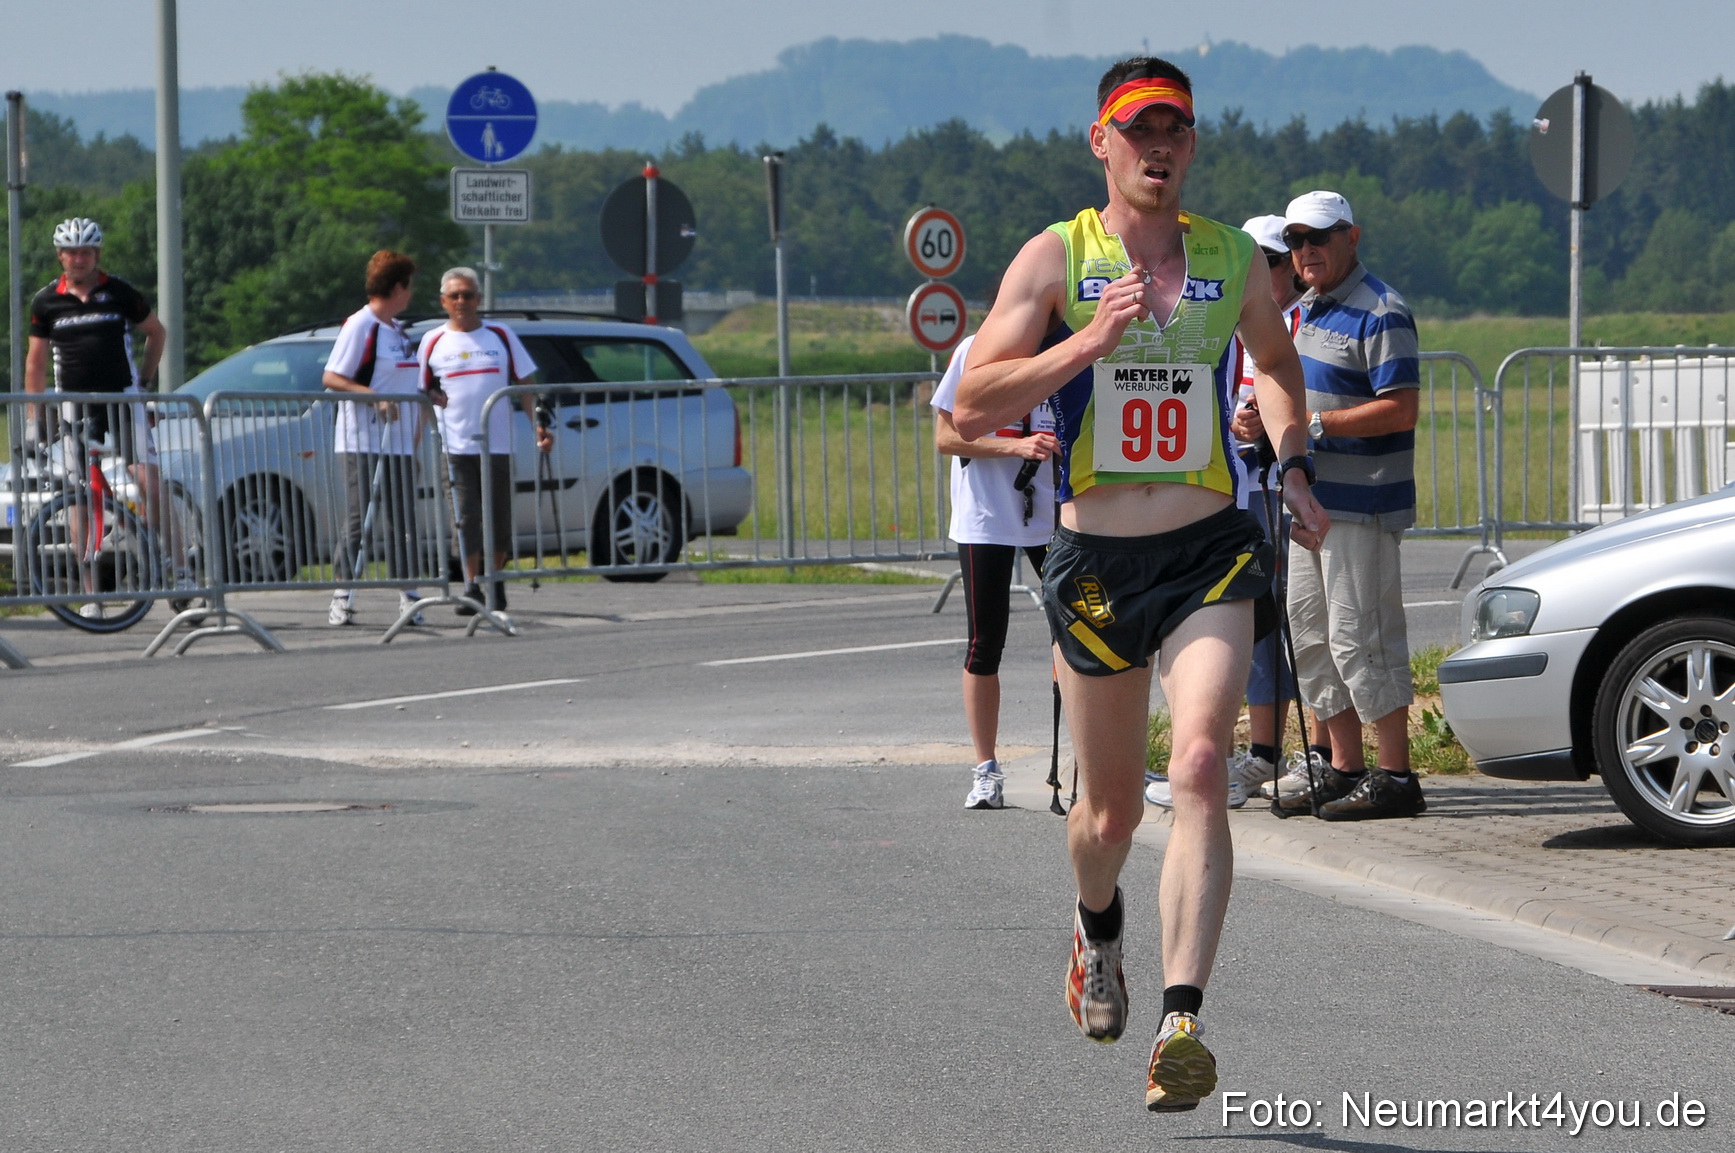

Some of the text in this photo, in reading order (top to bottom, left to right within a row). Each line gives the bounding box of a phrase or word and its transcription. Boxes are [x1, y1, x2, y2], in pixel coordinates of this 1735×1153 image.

[466, 175, 517, 188] Landwirt-
[460, 190, 522, 202] schaftlicher
[460, 203, 523, 216] Verkehr frei
[921, 228, 952, 259] 60
[1114, 369, 1169, 381] MEYER
[1114, 382, 1169, 391] WERBUNG
[1121, 398, 1187, 462] 99
